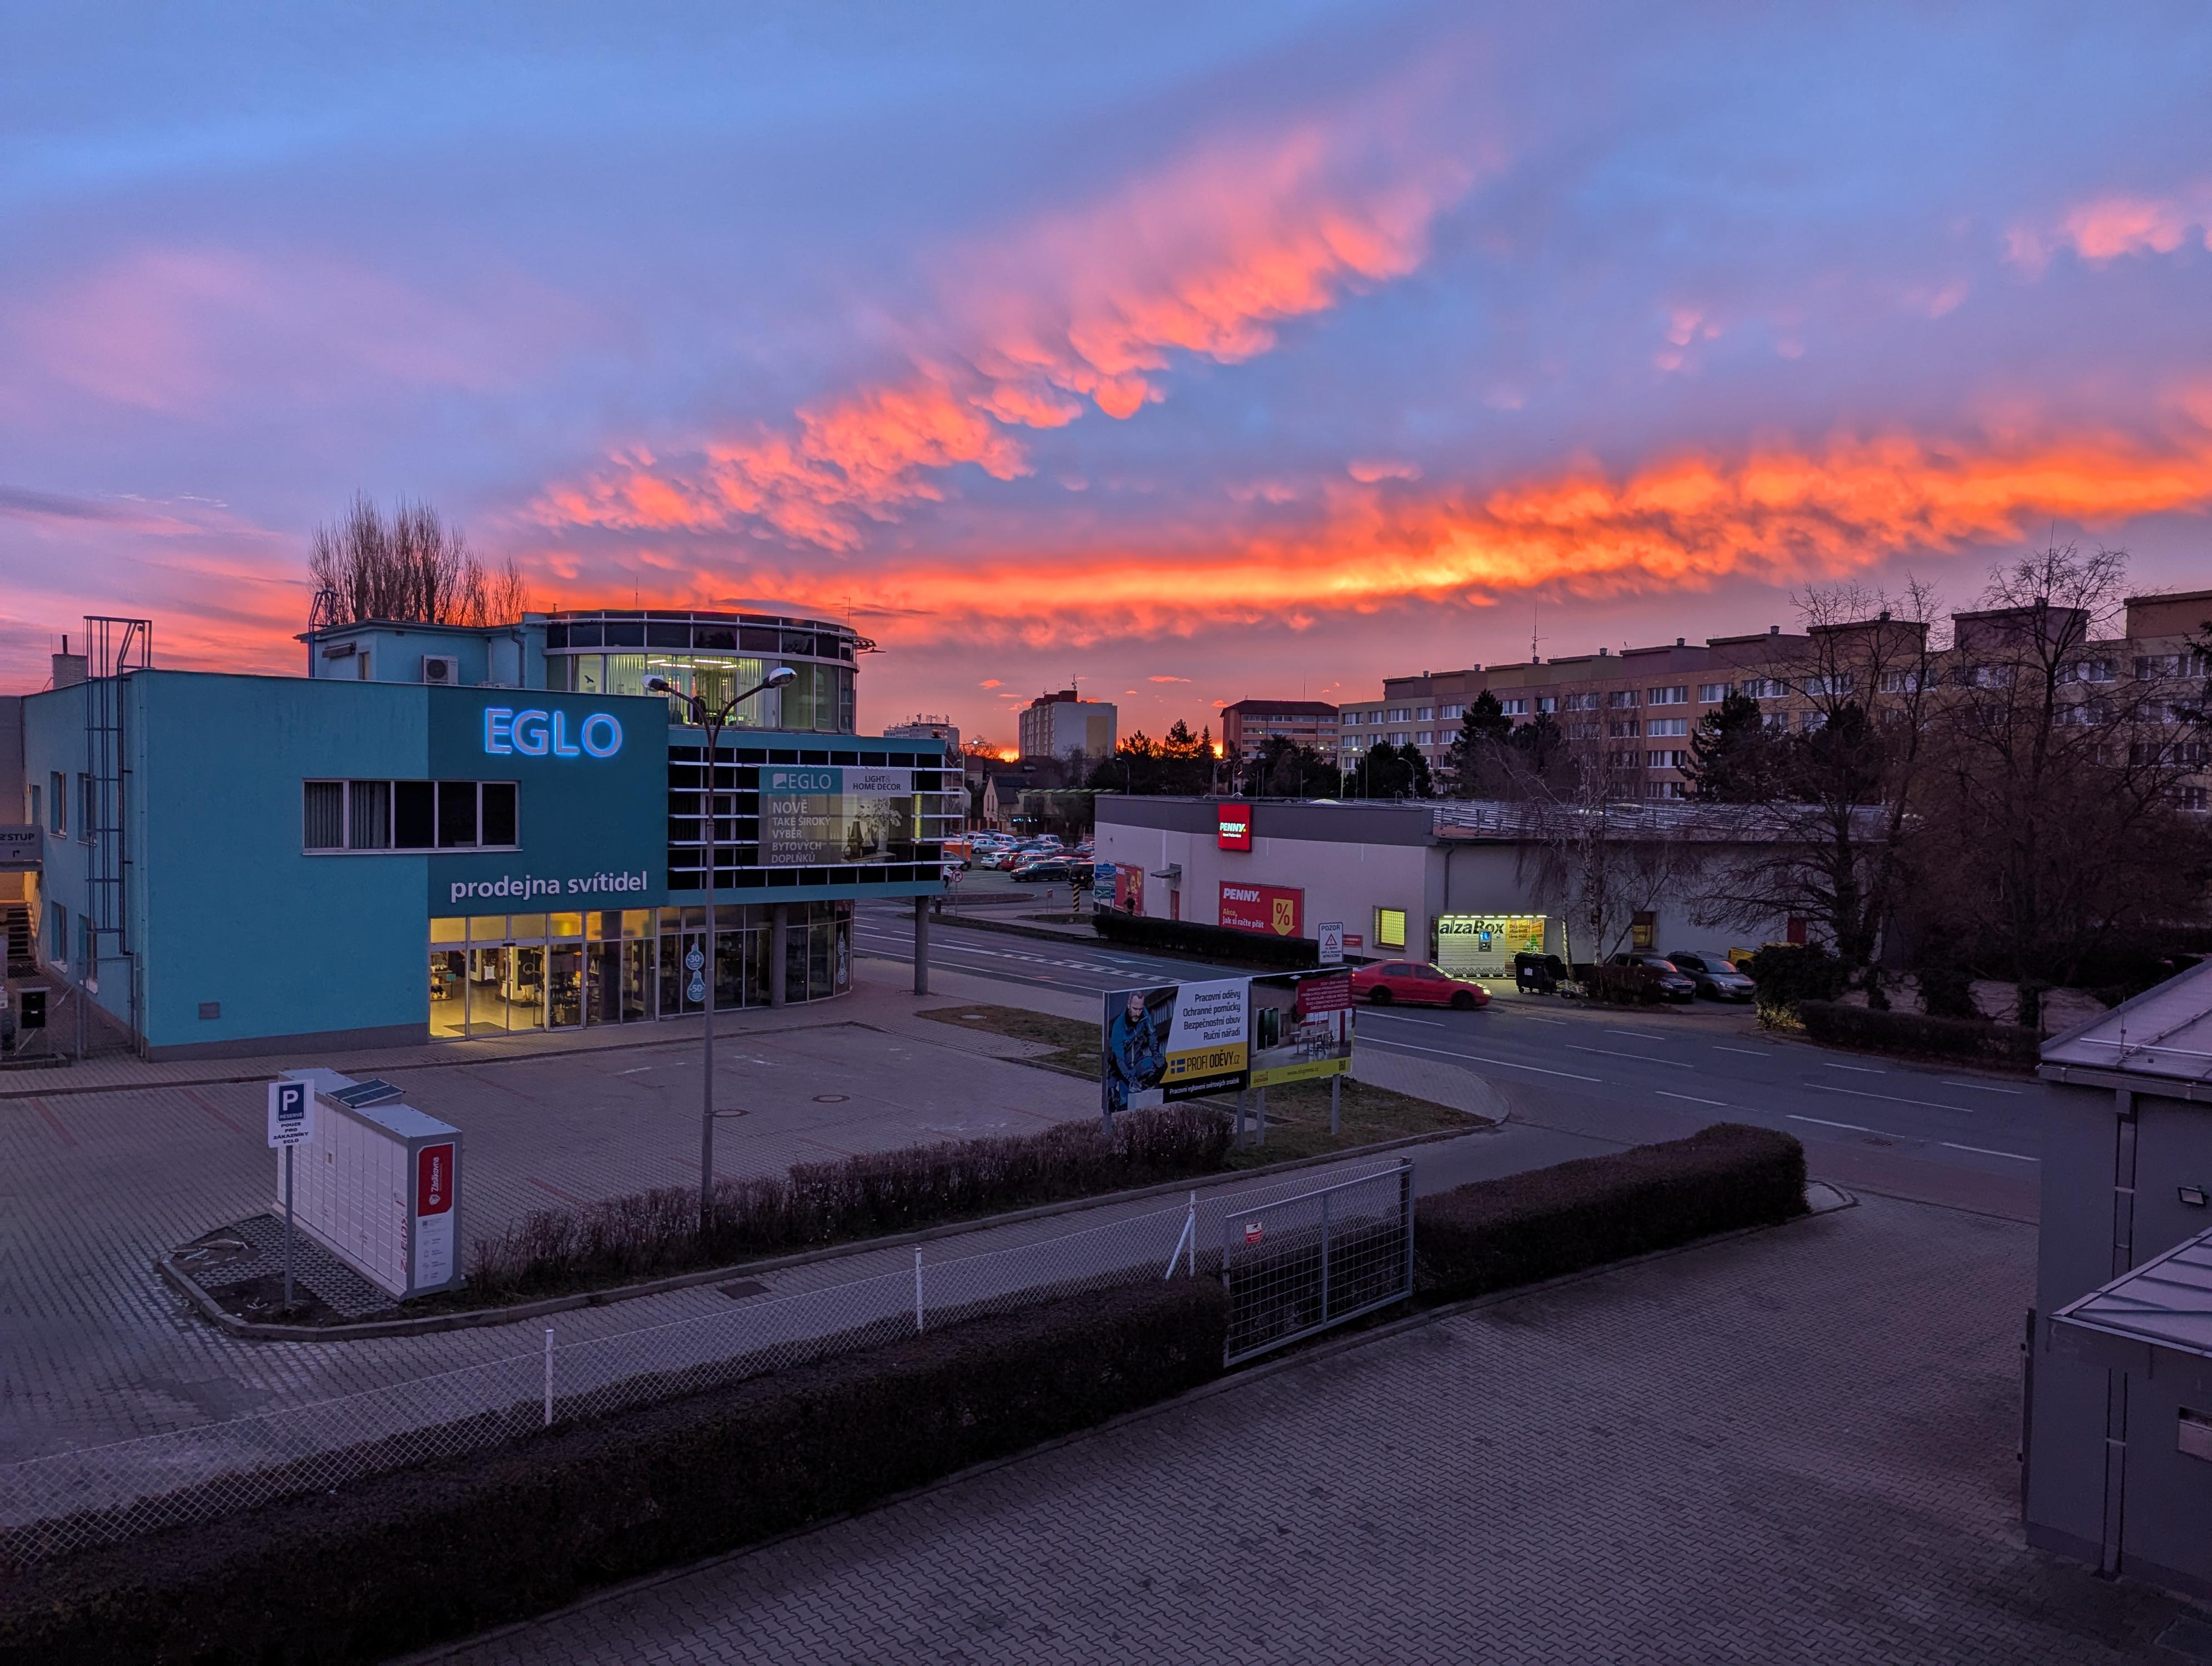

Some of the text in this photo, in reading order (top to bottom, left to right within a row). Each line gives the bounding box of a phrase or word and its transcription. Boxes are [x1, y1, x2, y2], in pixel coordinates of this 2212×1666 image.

[486, 709, 622, 757] EGLO
[789, 774, 831, 790] EGLO
[853, 782, 875, 791] HOME
[772, 799, 807, 814] NOVĚ
[772, 814, 831, 826] TAKÉ ŠIROKÝ
[772, 828, 802, 839] VÝBĚR
[772, 840, 822, 851] BYTOVÝCH
[772, 851, 816, 864] DOPLŇKŮ
[451, 871, 647, 904] prodejna svítidel
[1223, 908, 1238, 917] Akce,
[1276, 902, 1290, 926] %
[1223, 916, 1231, 925] jak
[1238, 918, 1251, 926] račte
[1252, 920, 1264, 929] přát
[1439, 920, 1505, 934] alzaBox
[1195, 990, 1241, 1002] Pracovní oděvy
[1183, 1002, 1241, 1017] Ochranné pomůcky
[1184, 1015, 1241, 1031] Bezpečnostní obuv
[1204, 1026, 1241, 1041] Ruční nářadí
[1187, 1055, 1208, 1072] PROFI
[283, 1090, 299, 1111] P
[431, 1157, 439, 1192] Zásilkovna
